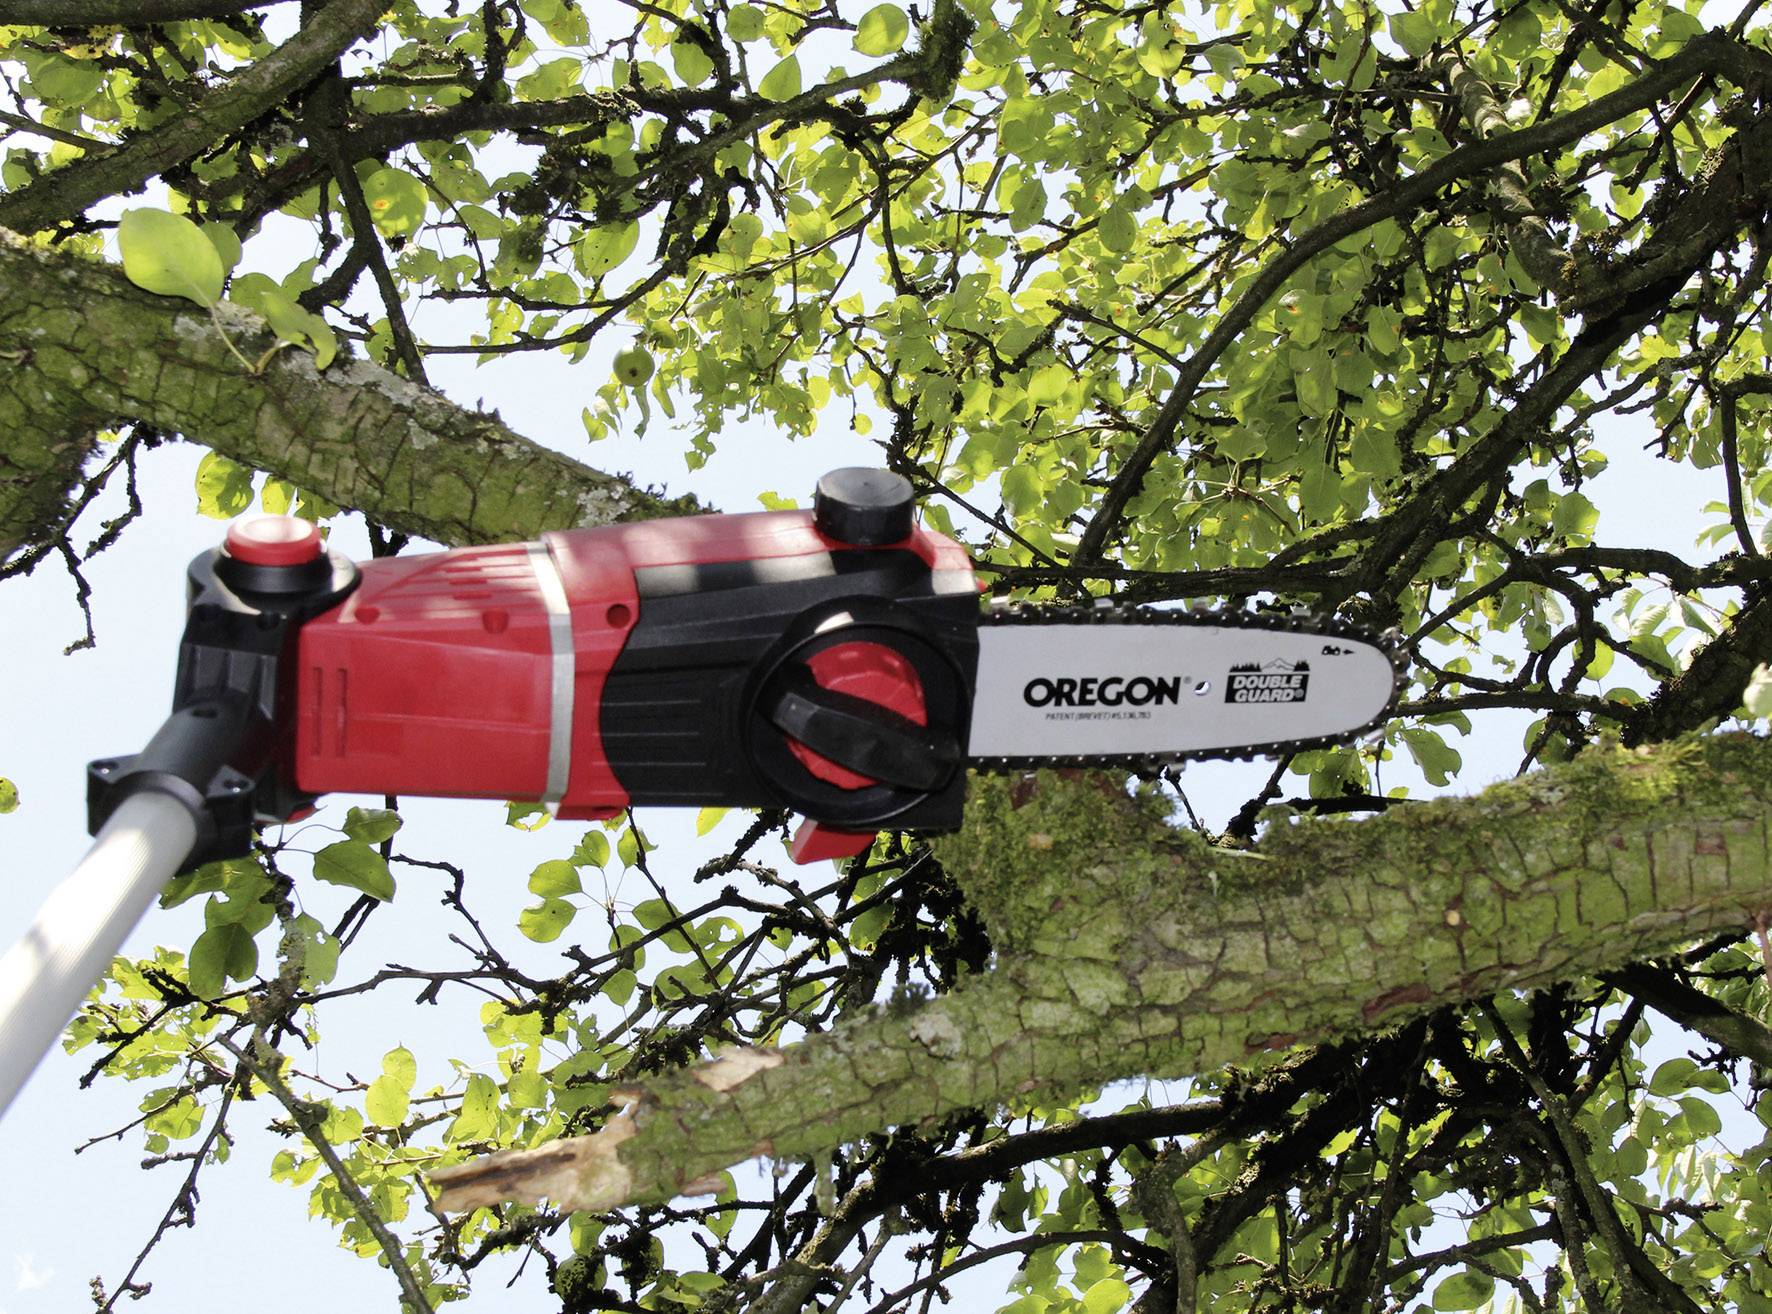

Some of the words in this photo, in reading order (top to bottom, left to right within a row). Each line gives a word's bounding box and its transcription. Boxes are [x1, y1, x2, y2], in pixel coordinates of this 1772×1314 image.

[1232, 675, 1303, 689] DOUBLE
[1023, 676, 1181, 708] OREGON
[1045, 712, 1075, 720] PATENT
